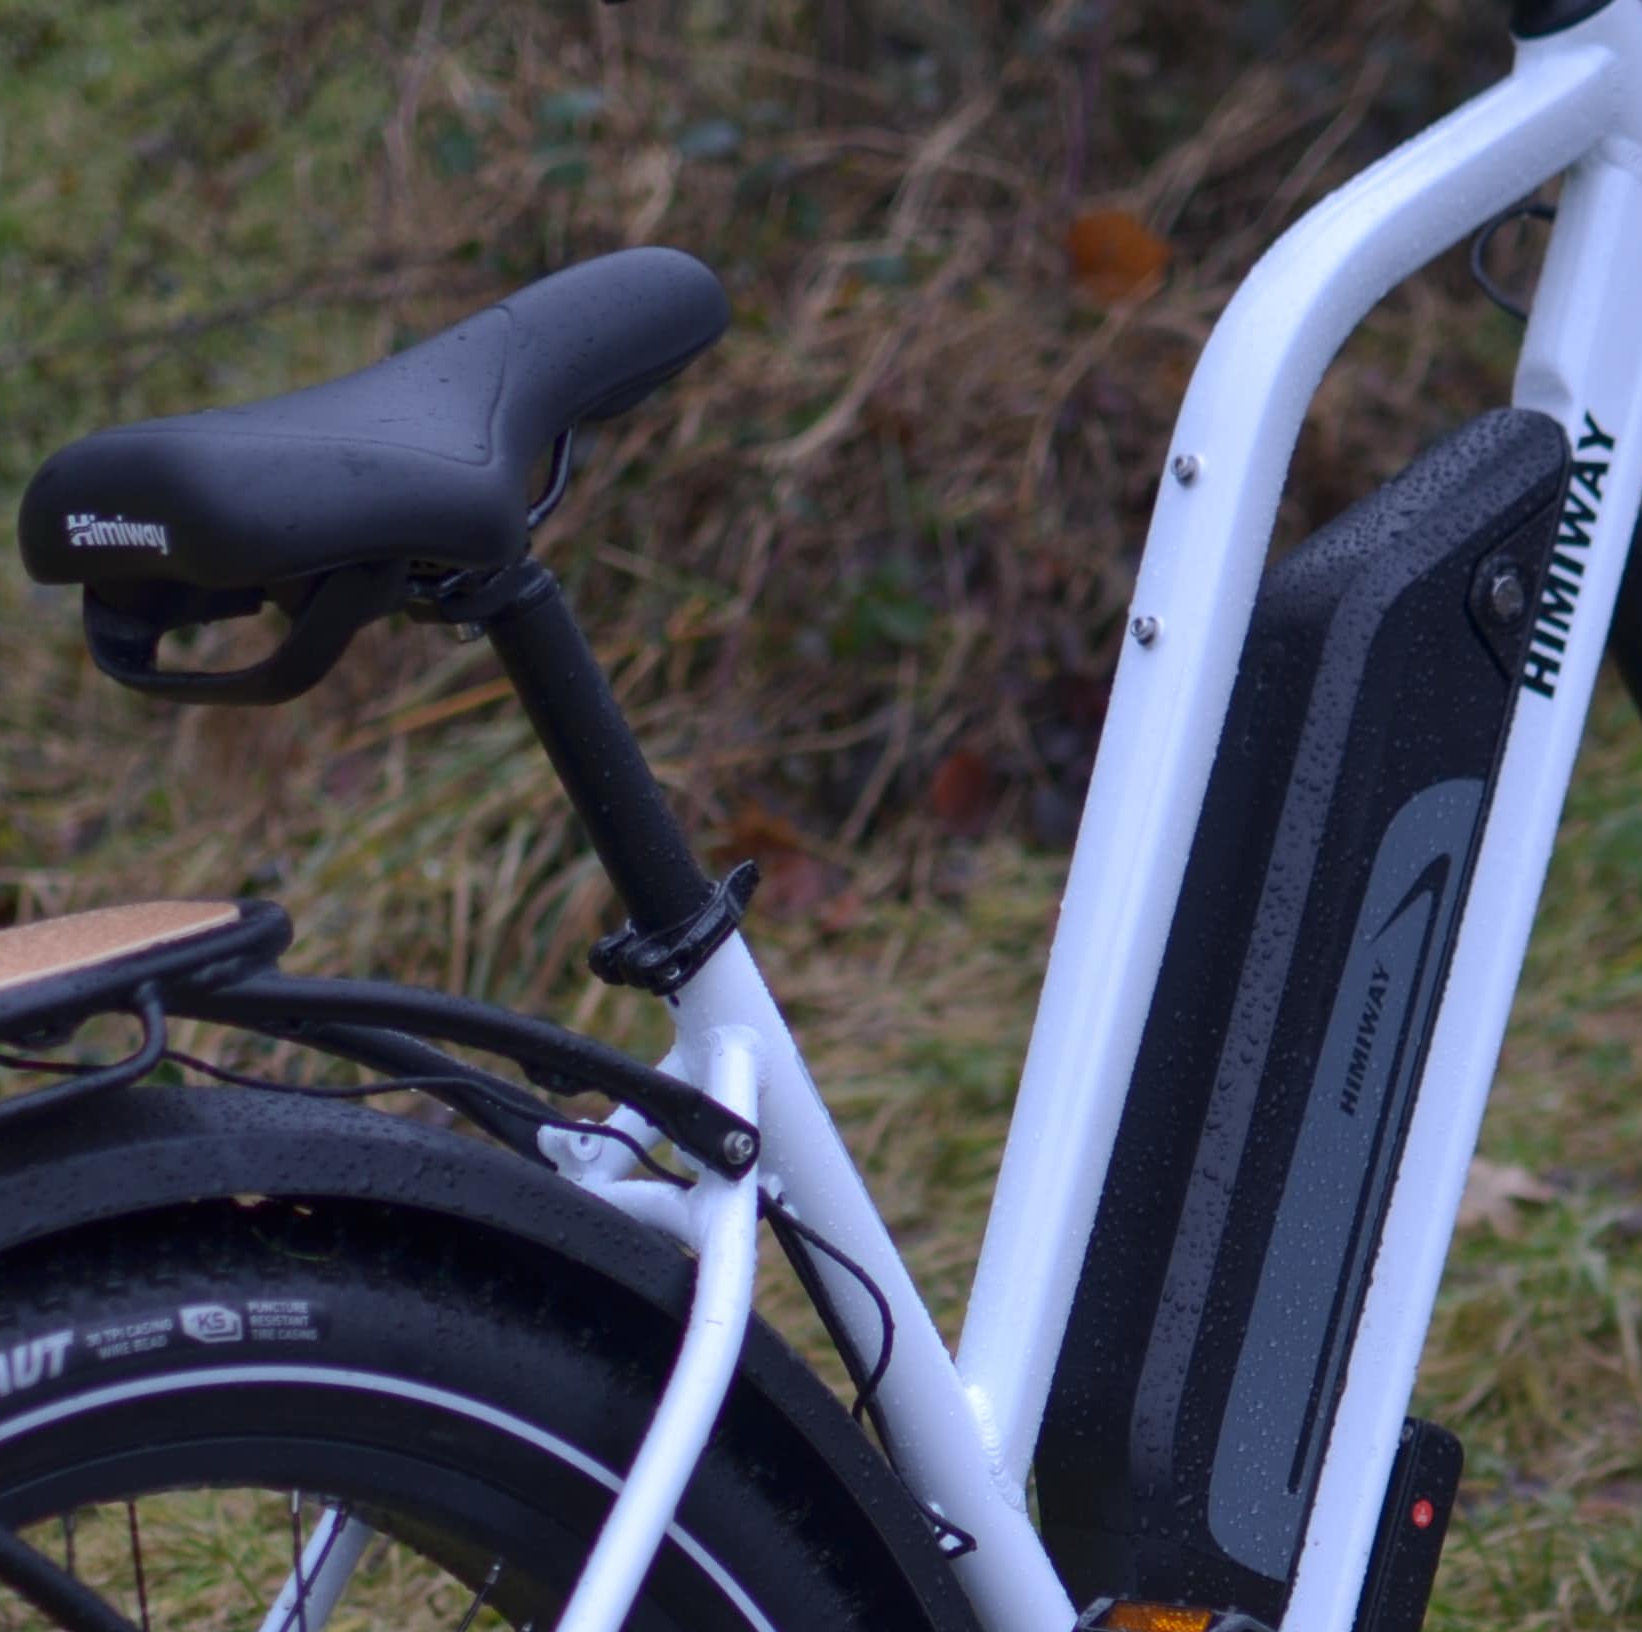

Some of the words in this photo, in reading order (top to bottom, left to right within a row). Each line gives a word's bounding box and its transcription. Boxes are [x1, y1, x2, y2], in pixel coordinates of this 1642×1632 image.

[66, 514, 168, 556] Himiway
[1520, 408, 1615, 700] HIMIWAY
[1338, 959, 1390, 1117] HIMIWAY
[247, 1301, 308, 1313] PUNCTURE
[197, 1310, 228, 1330] KS
[249, 1315, 309, 1327] RESISTANT
[251, 1328, 275, 1340] TIRE
[278, 1328, 318, 1340] CASING
[99, 1341, 131, 1360] WIRE
